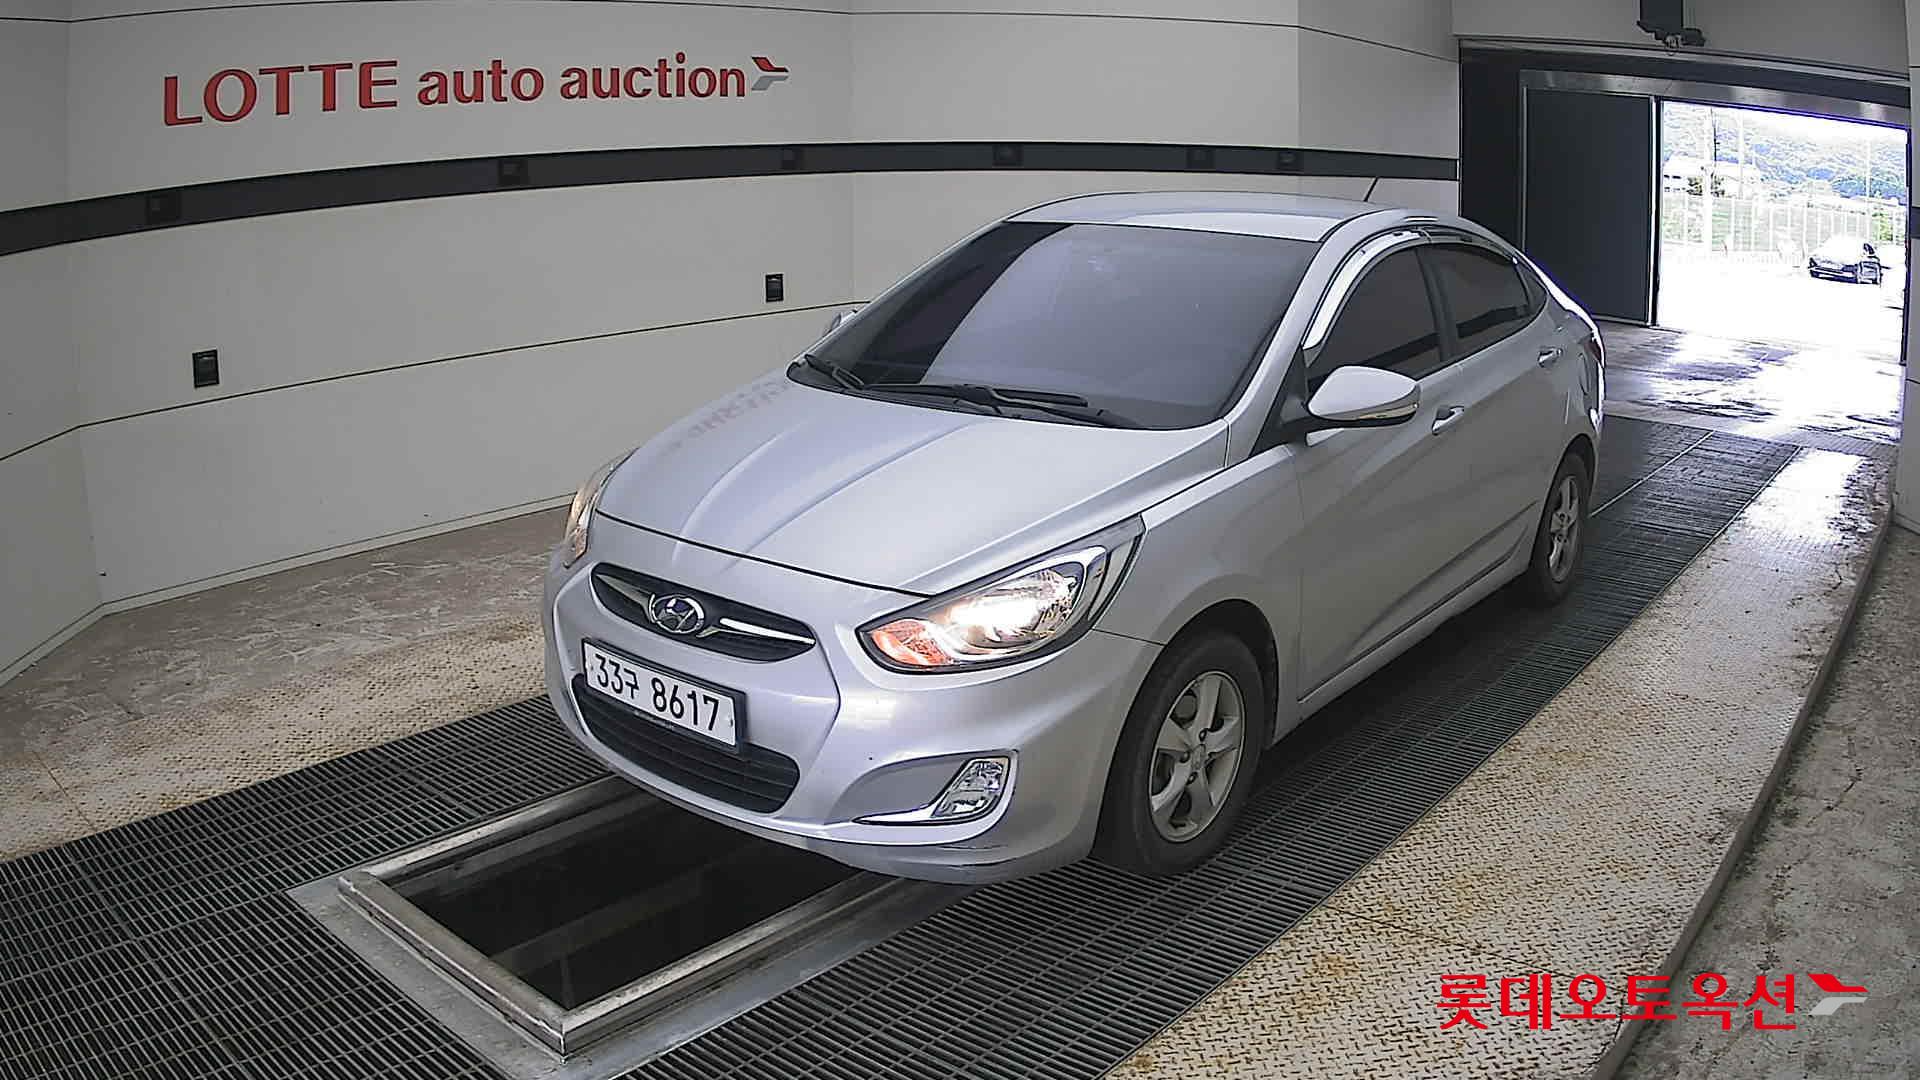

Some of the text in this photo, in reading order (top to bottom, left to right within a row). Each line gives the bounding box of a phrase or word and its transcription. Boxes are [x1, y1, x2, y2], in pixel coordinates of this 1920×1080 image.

[164, 52, 747, 127] LOTTE auto auction
[595, 653, 719, 731] 33구 8617
